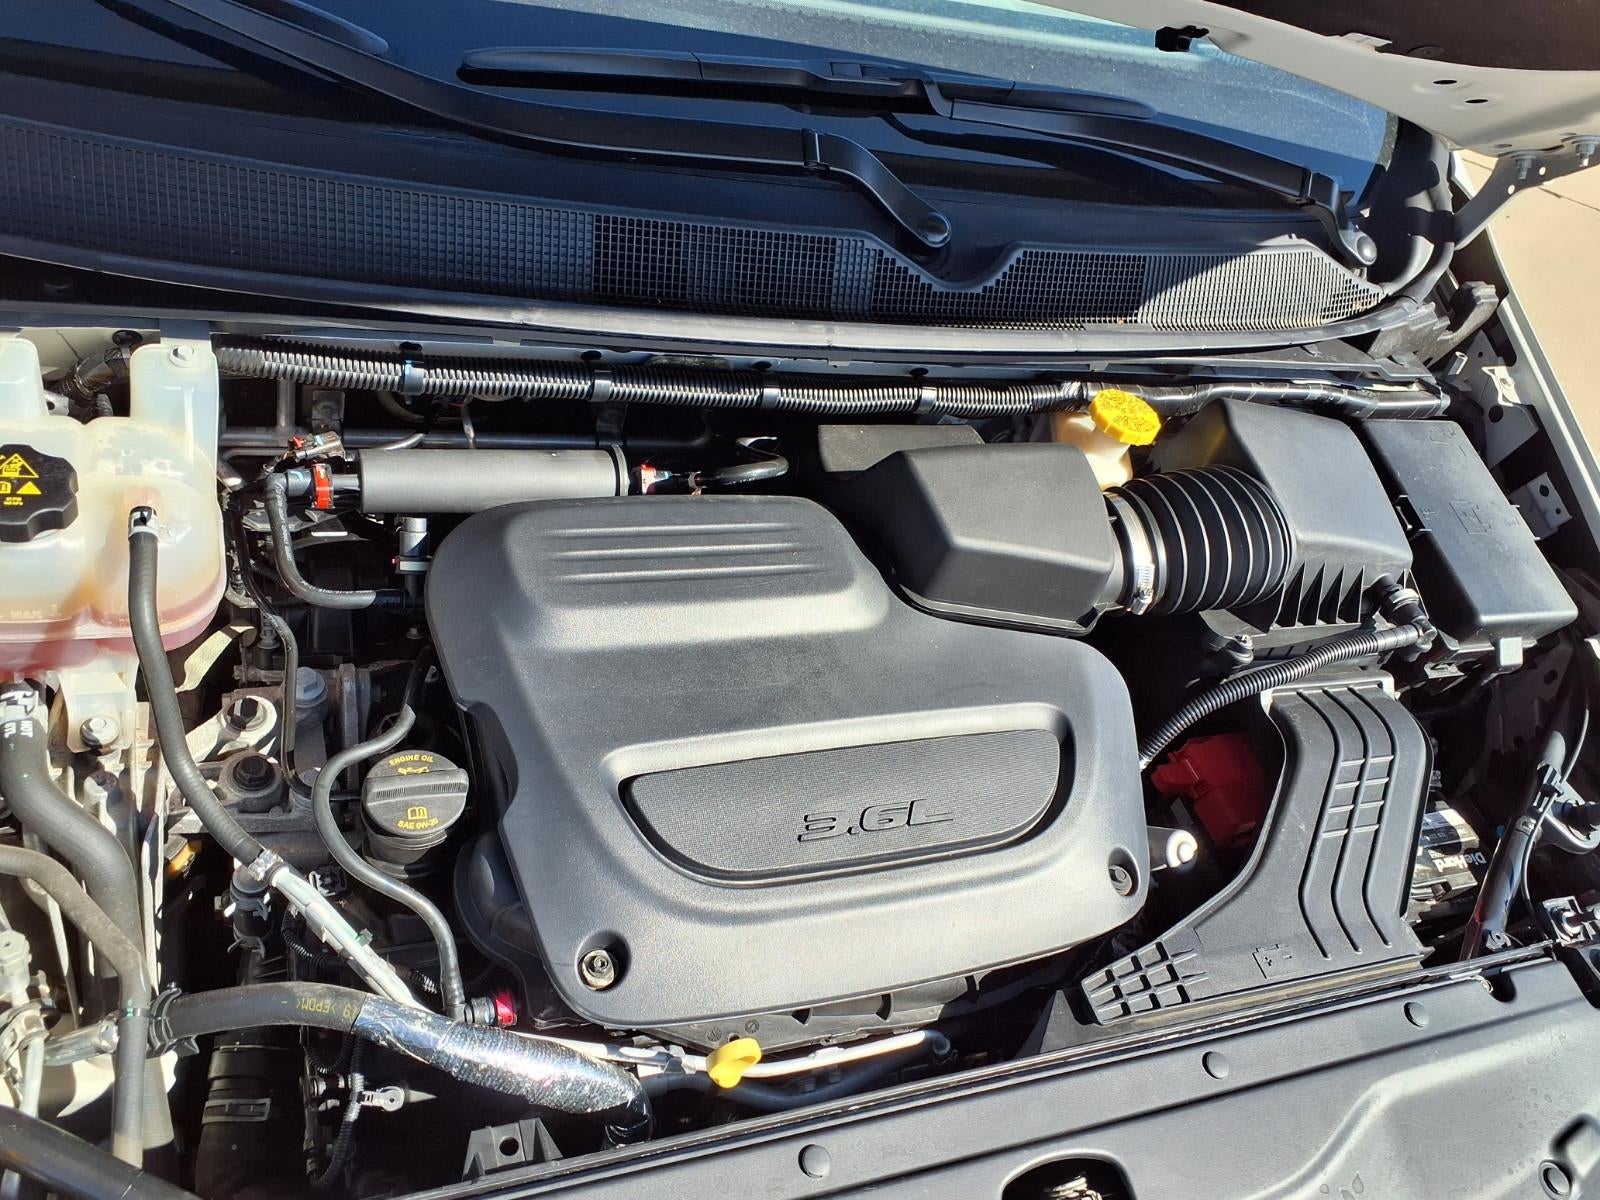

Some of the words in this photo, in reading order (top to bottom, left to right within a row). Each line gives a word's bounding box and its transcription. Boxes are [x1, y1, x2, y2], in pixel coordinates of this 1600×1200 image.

[389, 754, 420, 766] ENGINE
[421, 754, 434, 763] OIL
[397, 820, 415, 829] SAE
[416, 818, 439, 829] 0W-20
[797, 799, 954, 843] 3.6L
[1432, 851, 1487, 873] DieHard
